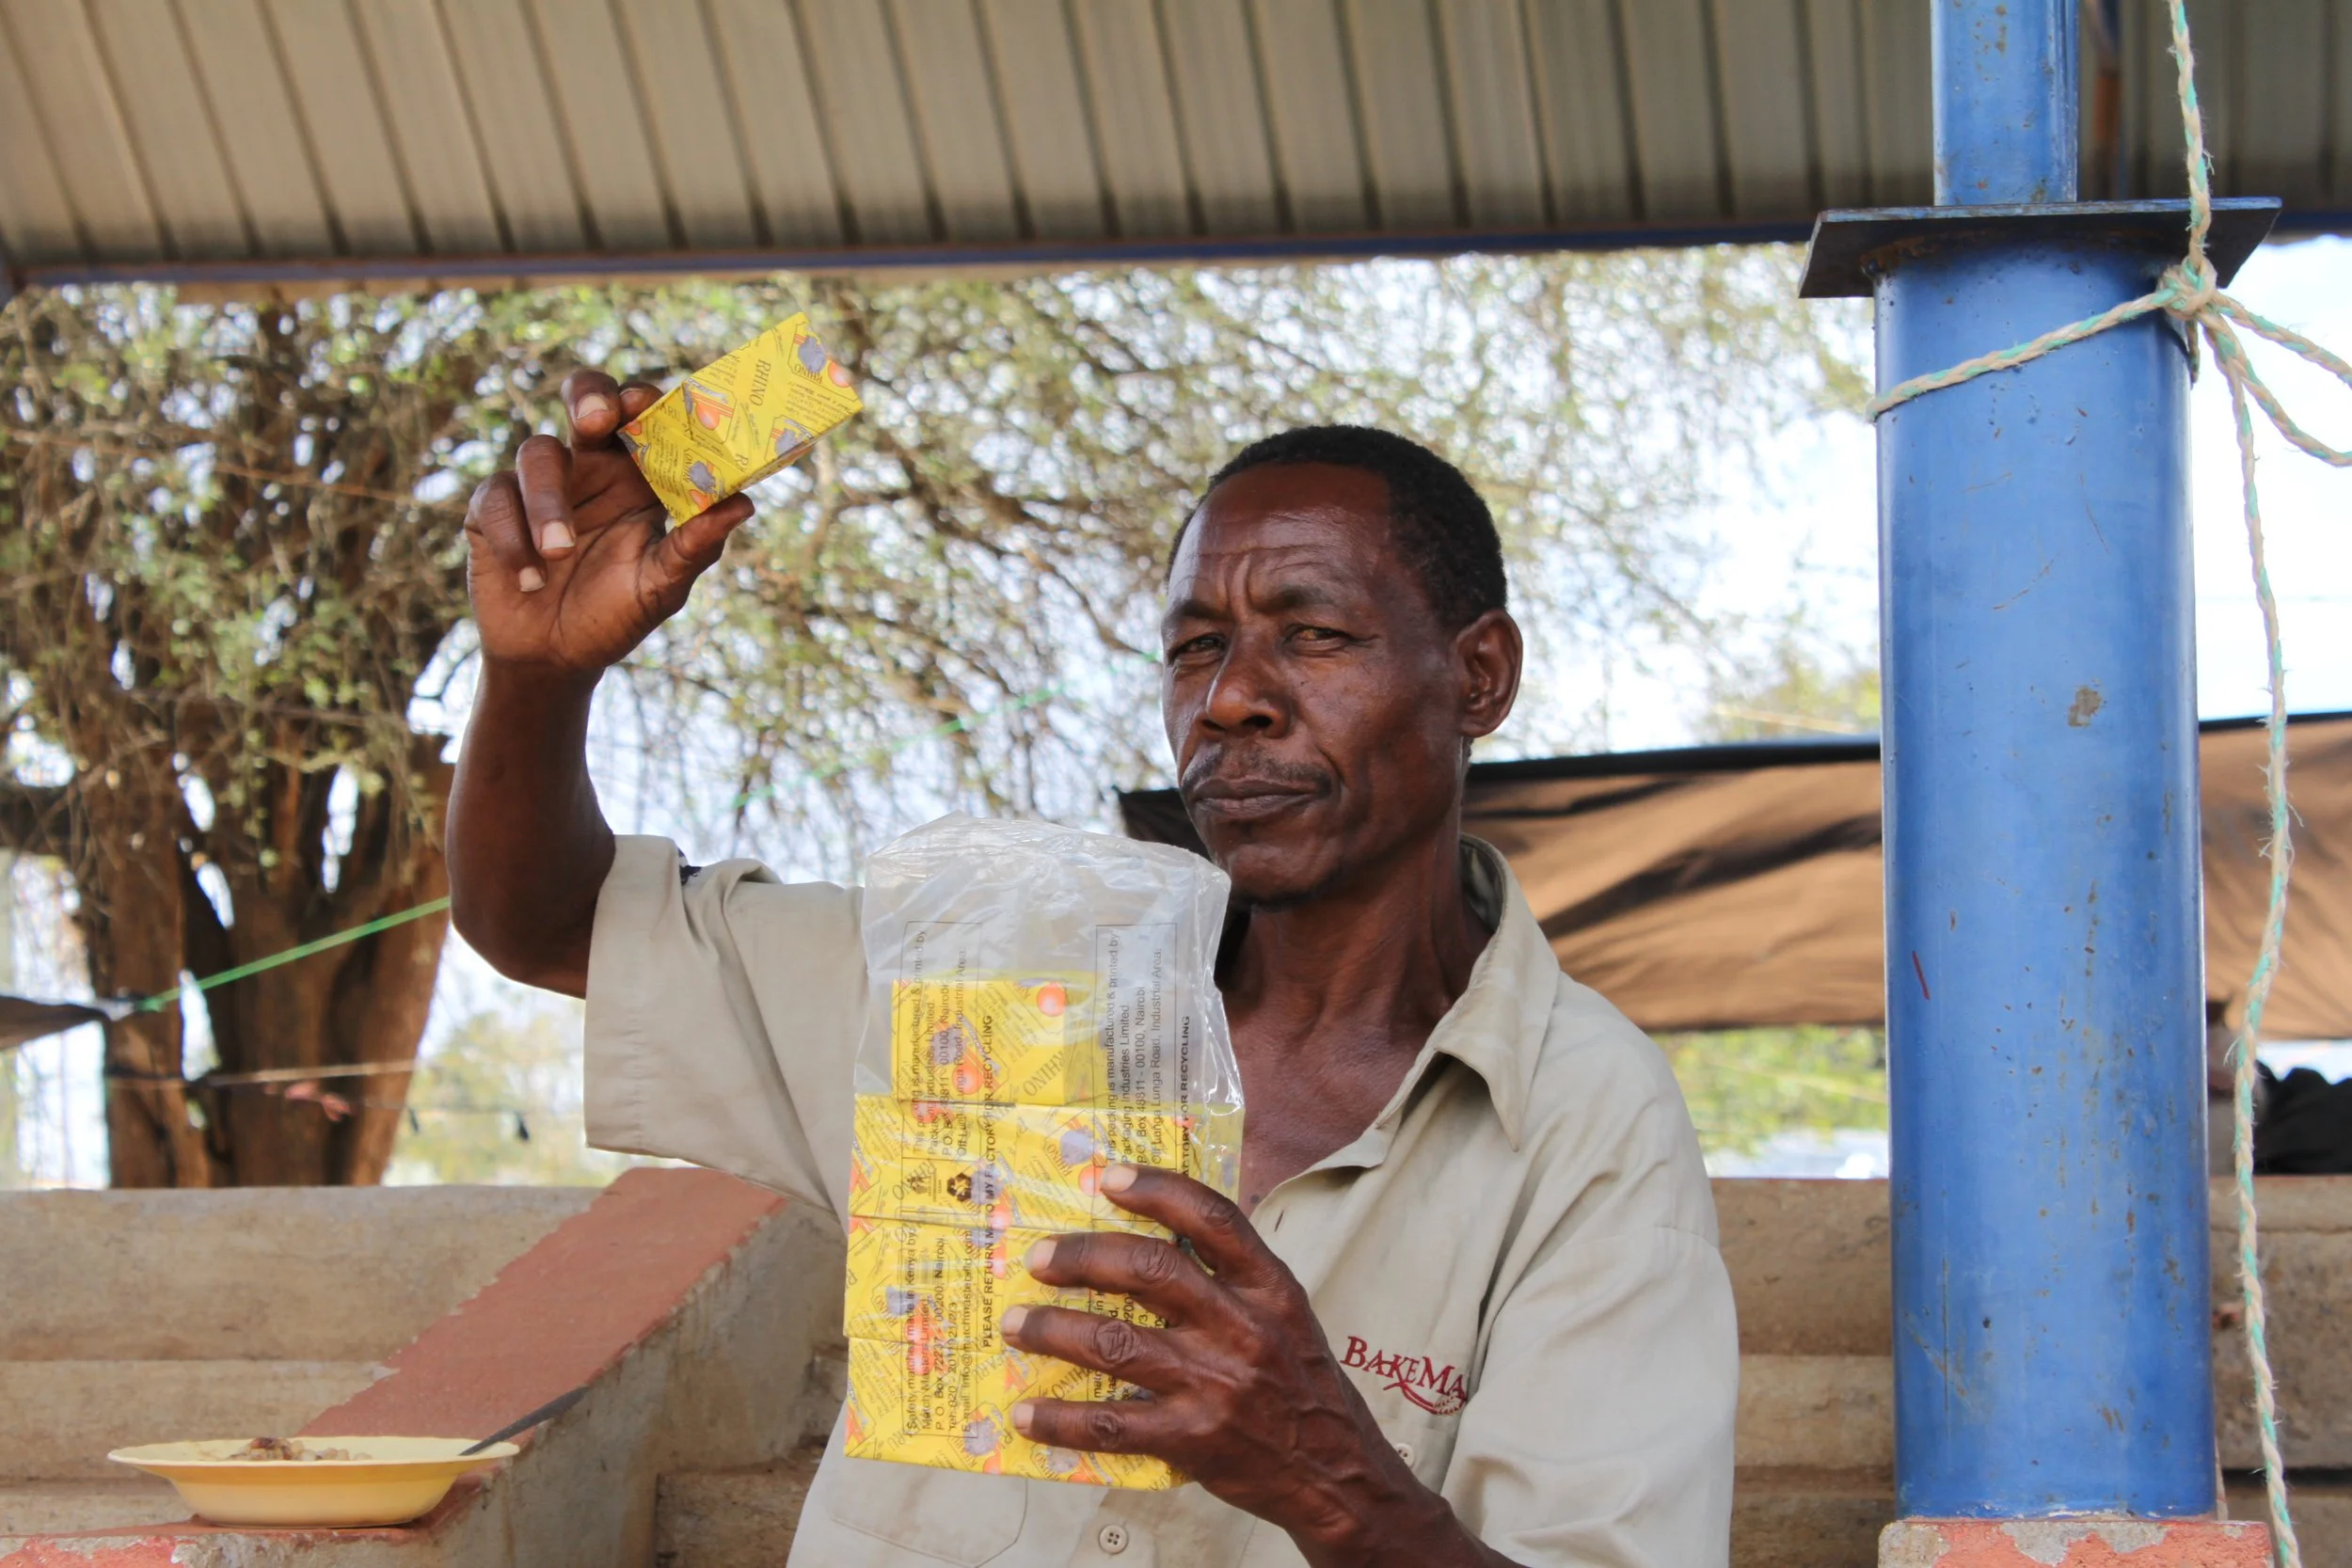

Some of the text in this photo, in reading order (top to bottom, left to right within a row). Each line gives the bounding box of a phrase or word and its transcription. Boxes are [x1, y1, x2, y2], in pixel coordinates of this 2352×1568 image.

[749, 357, 772, 406] RHINO
[794, 364, 824, 385] RHINO
[915, 930, 927, 942] by
[939, 984, 949, 1024] Nairobi
[954, 981, 963, 1030] Industrial
[1136, 986, 1146, 1026] Nairobi
[1151, 981, 1161, 1032] Industrial
[910, 999, 921, 1074] manufactured
[982, 1015, 993, 1089] RECYCLING
[1104, 933, 1120, 1162] This packing is manufactured & printed by
[1181, 1016, 1190, 1091] RECYCLING
[926, 1045, 937, 1099] Industries
[1120, 1048, 1131, 1102] Industries
[1151, 1071, 1163, 1107] Lunga
[911, 1090, 926, 1127] paking
[1136, 1080, 1146, 1114] 48811
[913, 1132, 924, 1155] This
[1121, 1105, 1134, 1164] Packaging
[1136, 1115, 1147, 1138] Box
[1151, 1110, 1164, 1145] Lunga
[984, 1120, 995, 1178] FACTORY
[1152, 1148, 1162, 1164] Off
[1182, 1125, 1190, 1177] ACTORY
[985, 1181, 994, 1200] MY
[907, 1248, 918, 1286] Kenya
[984, 1242, 994, 1294] RETURN
[983, 1298, 993, 1348] PLEASE
[934, 1376, 944, 1399] Box
[948, 1386, 958, 1408] 020
[1052, 1367, 1090, 1400] HINO
[907, 1393, 918, 1430] Safety
